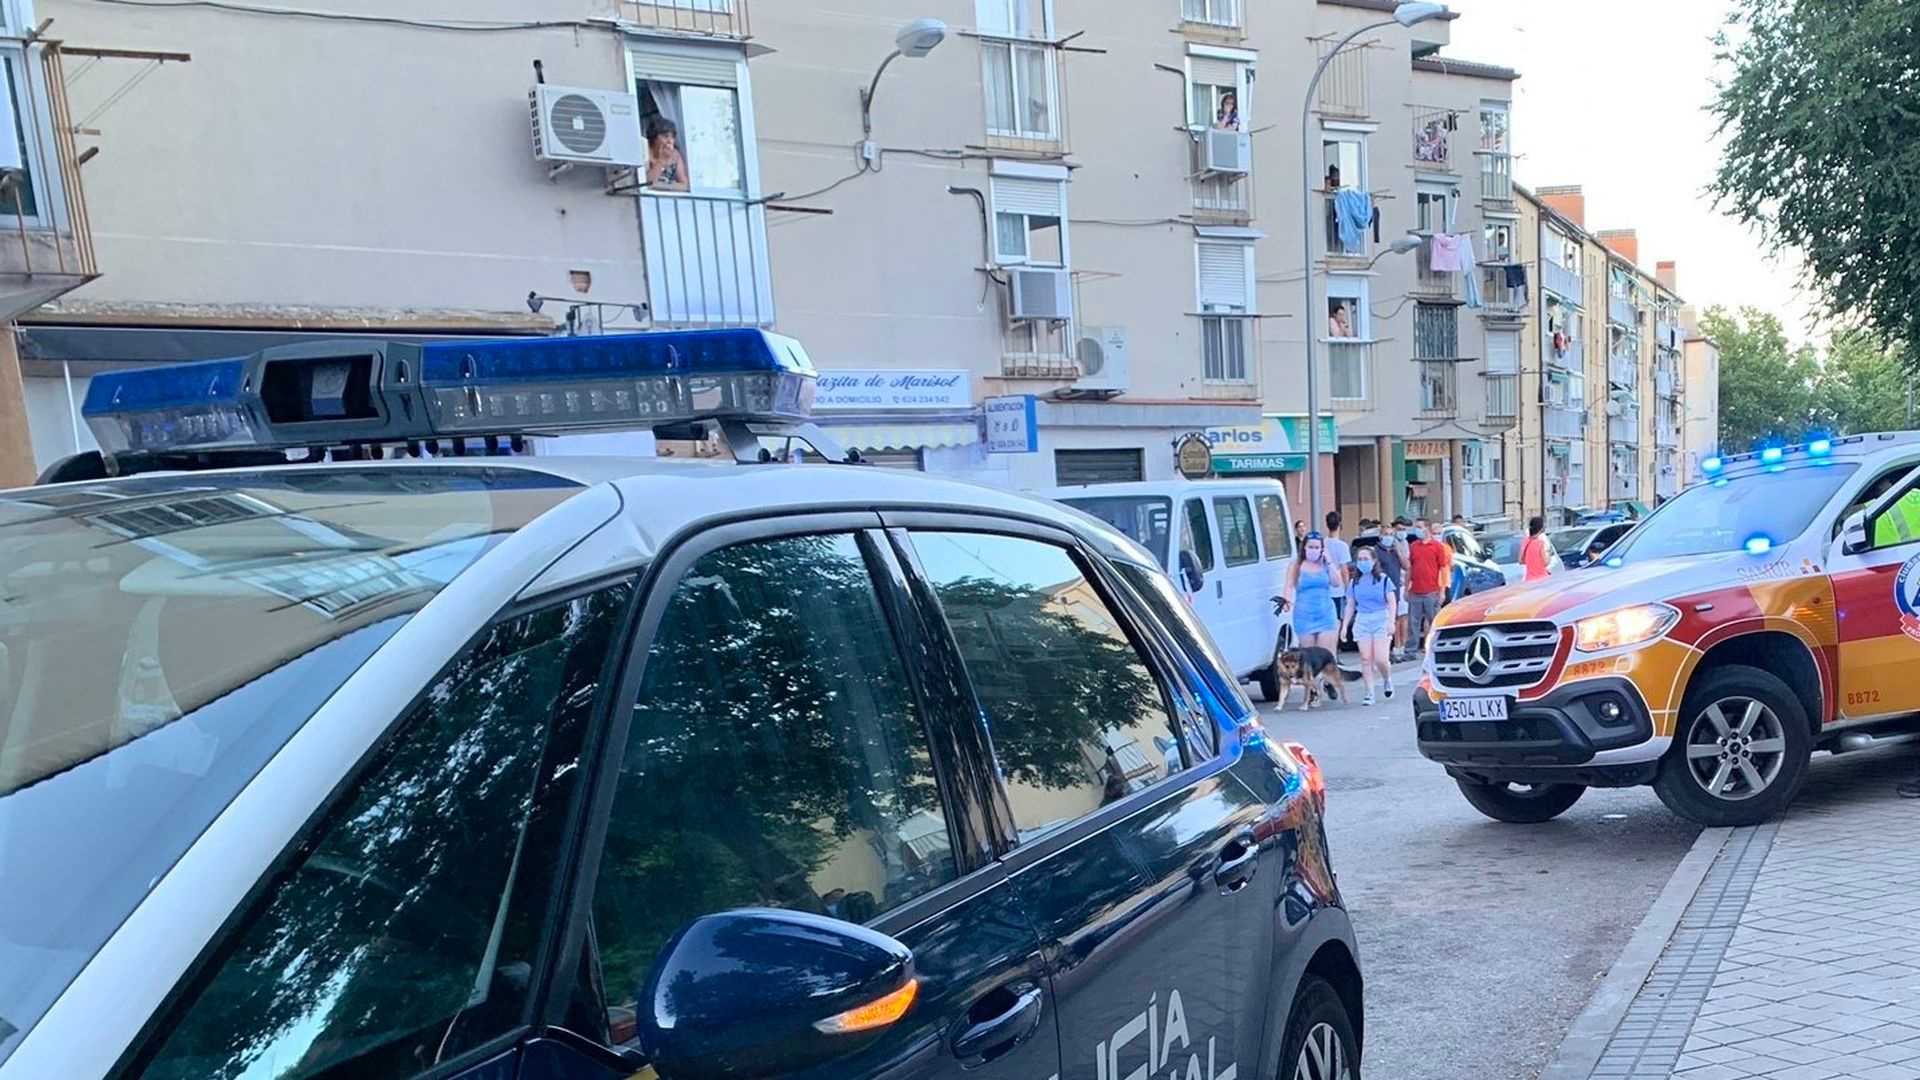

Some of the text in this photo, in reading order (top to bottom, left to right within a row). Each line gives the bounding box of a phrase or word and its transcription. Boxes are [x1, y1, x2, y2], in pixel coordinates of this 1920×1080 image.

[864, 374, 885, 388] de
[890, 375, 960, 390] Marisol
[827, 396, 834, 404] A
[836, 396, 881, 404] DOMICILIO
[1208, 429, 1263, 443] arlos
[1406, 442, 1446, 455] FRUTAS
[1228, 458, 1285, 470] TARIMAS
[1737, 560, 1795, 582] SAMUR
[1573, 662, 1606, 676] 8872
[1847, 690, 1880, 706] 8872
[1446, 698, 1503, 719] 2504 LKX
